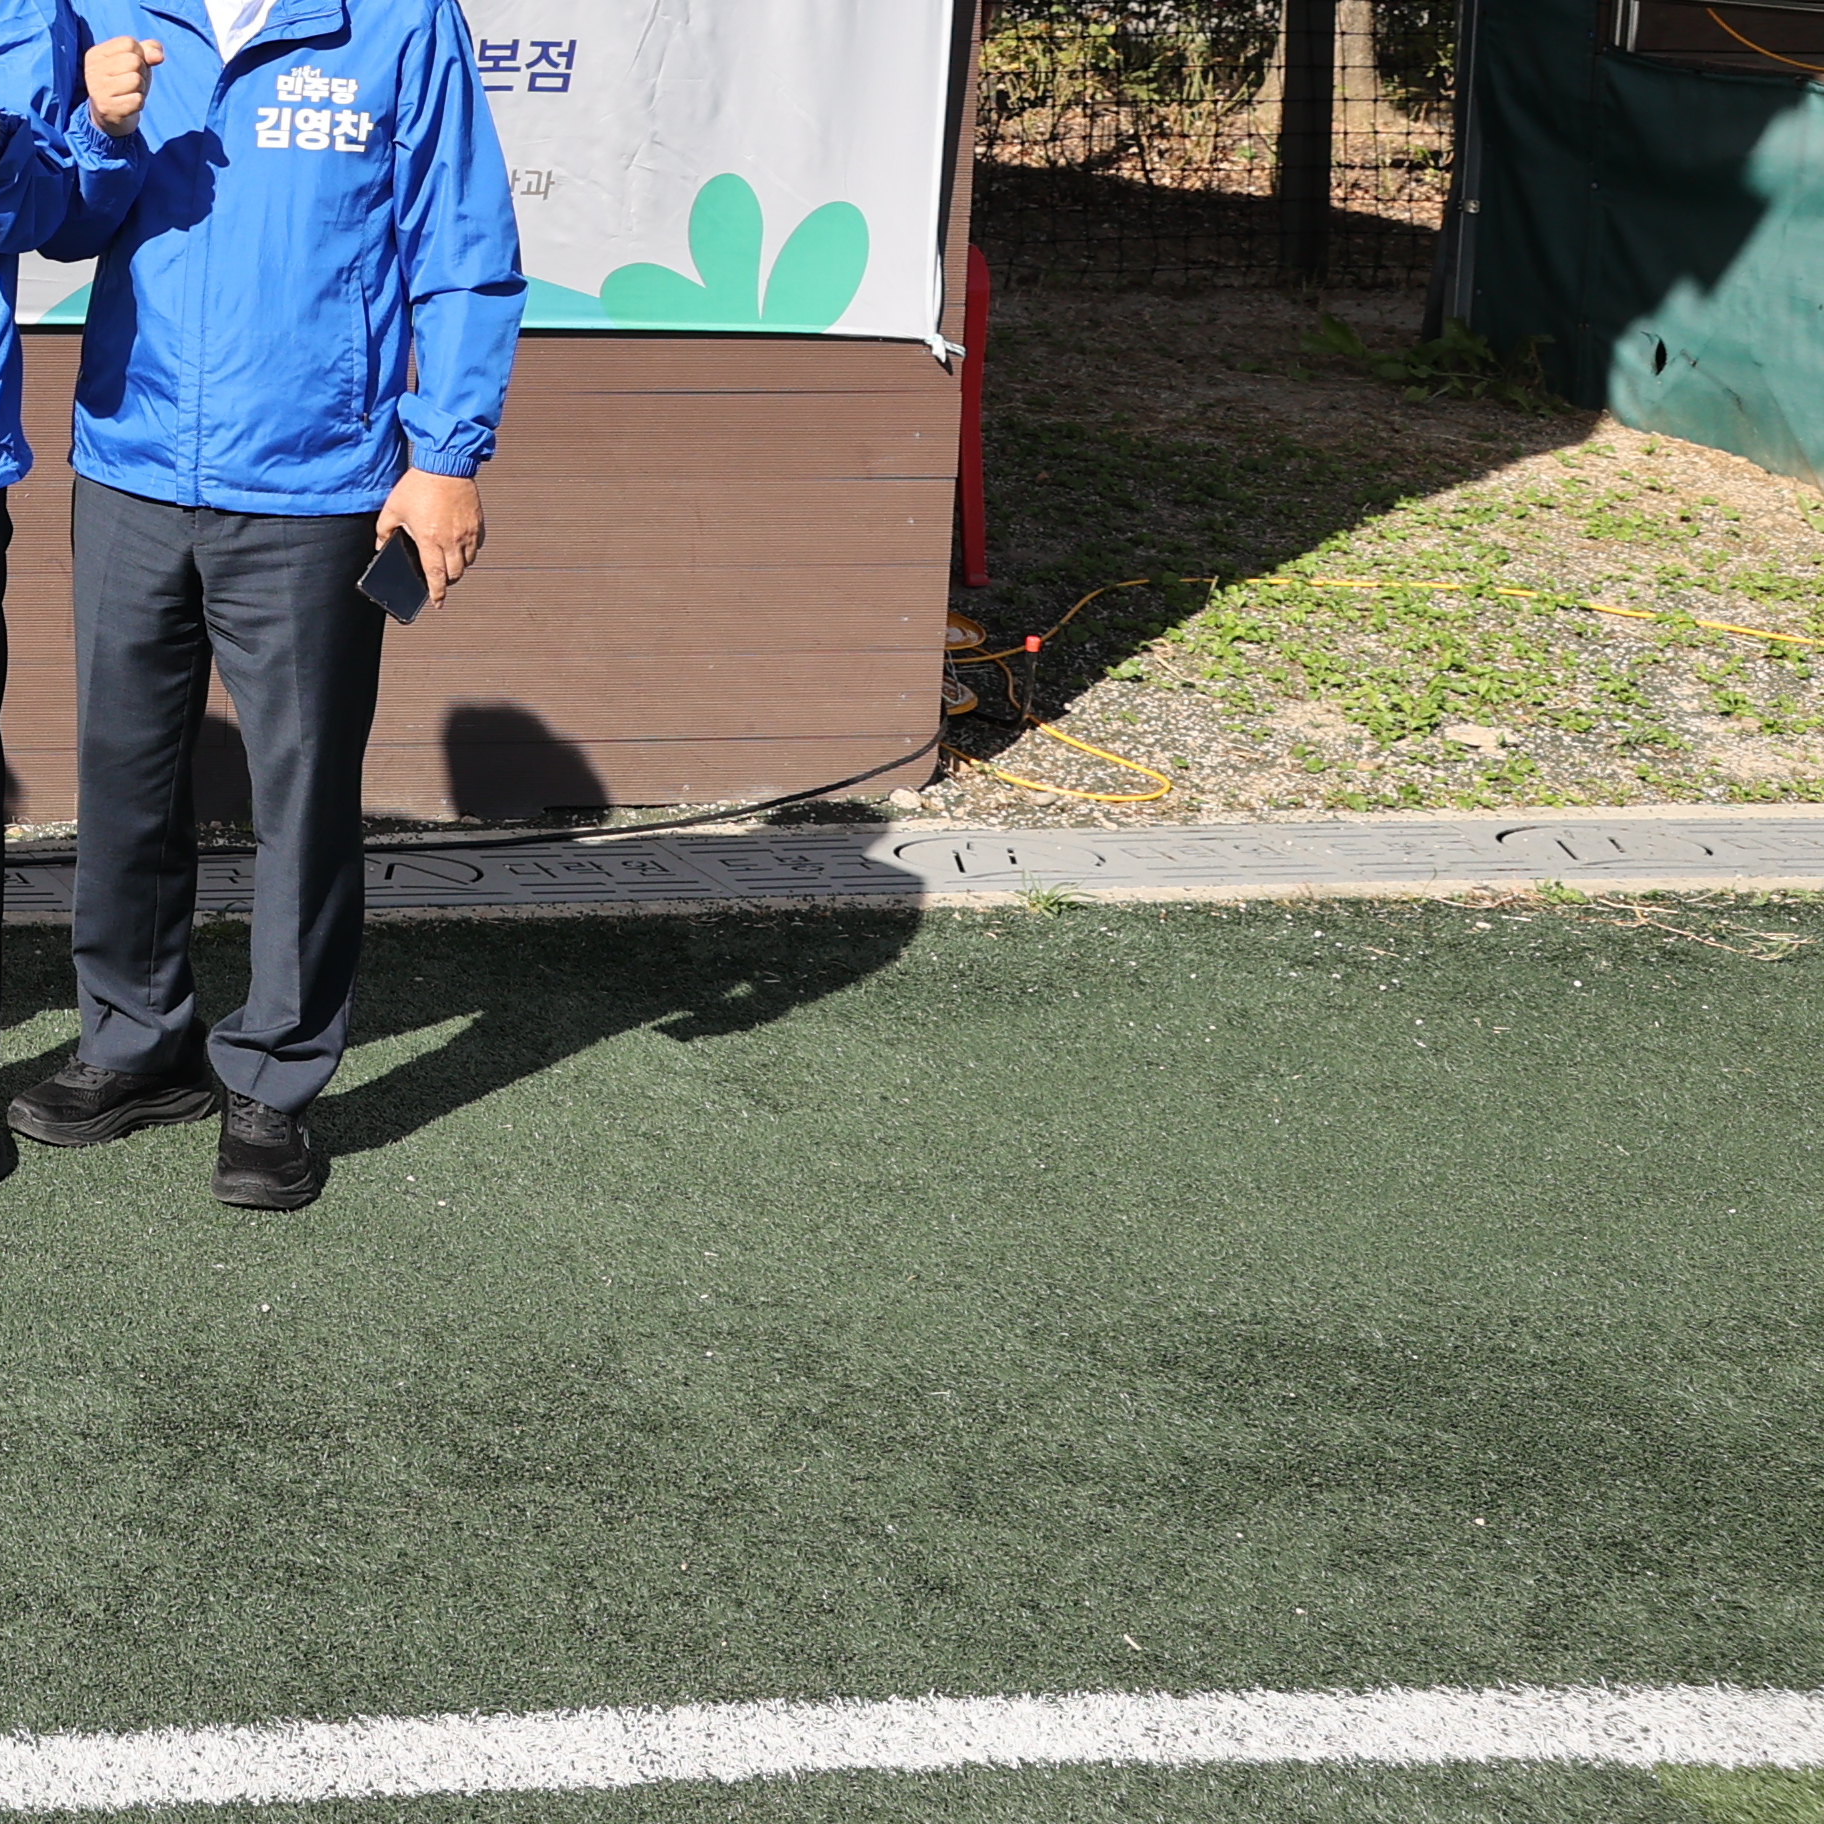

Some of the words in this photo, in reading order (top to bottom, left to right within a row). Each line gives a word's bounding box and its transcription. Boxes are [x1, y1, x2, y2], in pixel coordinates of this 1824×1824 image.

[276, 74, 359, 104] 민주당
[255, 107, 375, 153] 김영찬
[507, 859, 677, 879] 다락원
[717, 854, 882, 874] 도봉구
